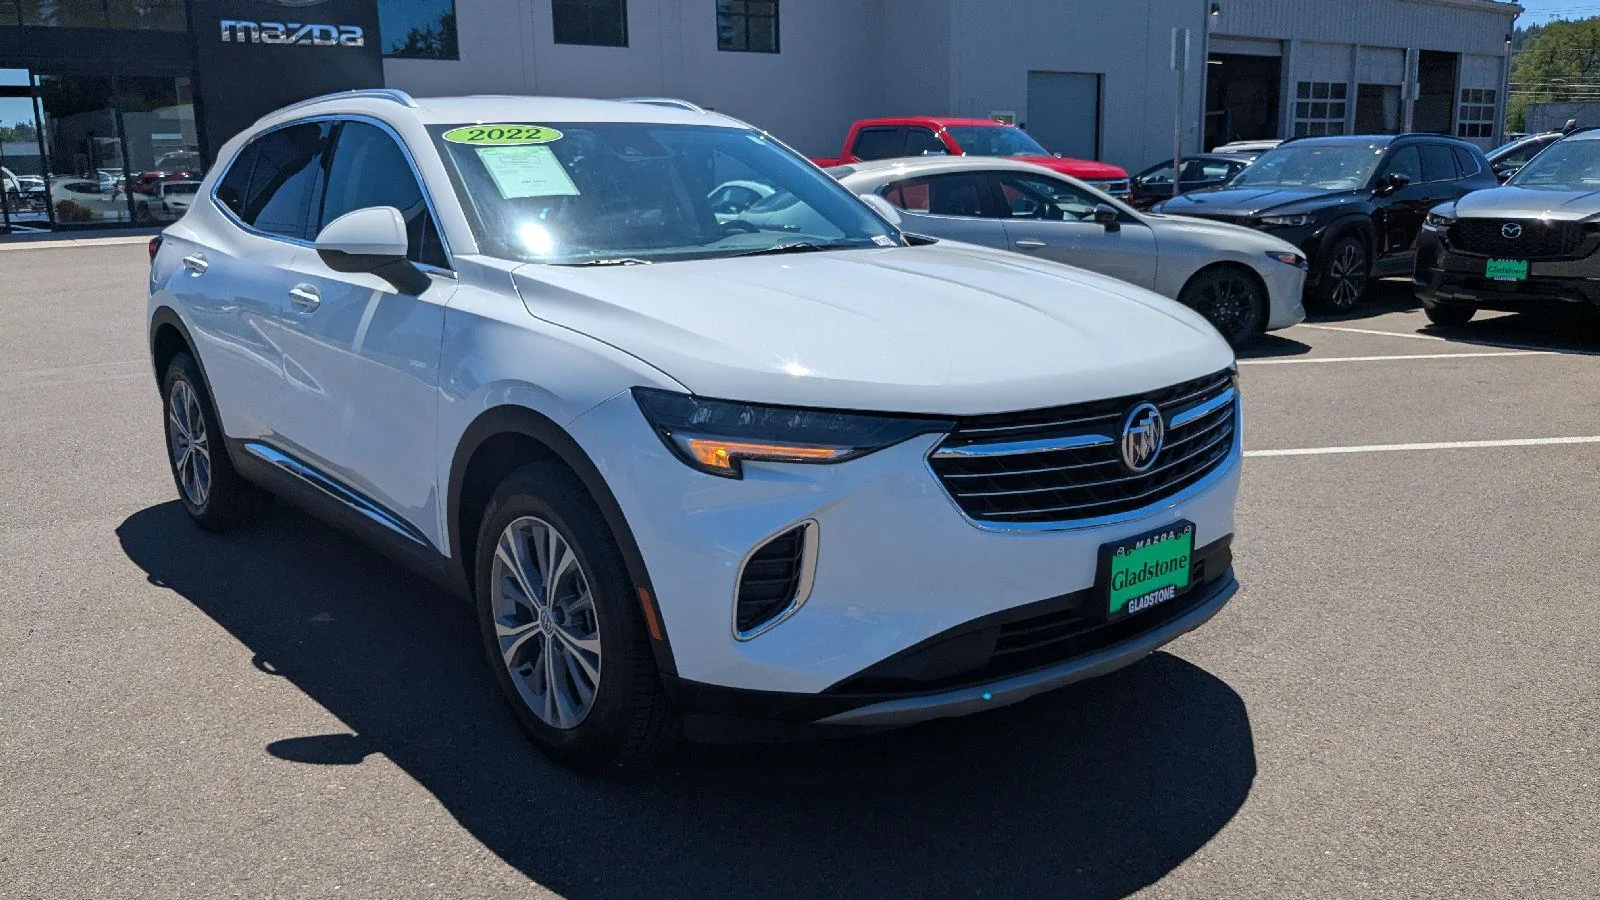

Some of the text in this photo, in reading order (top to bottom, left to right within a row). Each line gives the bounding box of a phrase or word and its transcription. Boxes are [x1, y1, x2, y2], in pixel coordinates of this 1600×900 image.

[467, 128, 541, 141] 2022
[1488, 266, 1526, 275] Gladstone
[1135, 530, 1175, 549] MAZDA
[1111, 554, 1188, 591] Gladstone
[1128, 585, 1176, 613] GLADSTONE
